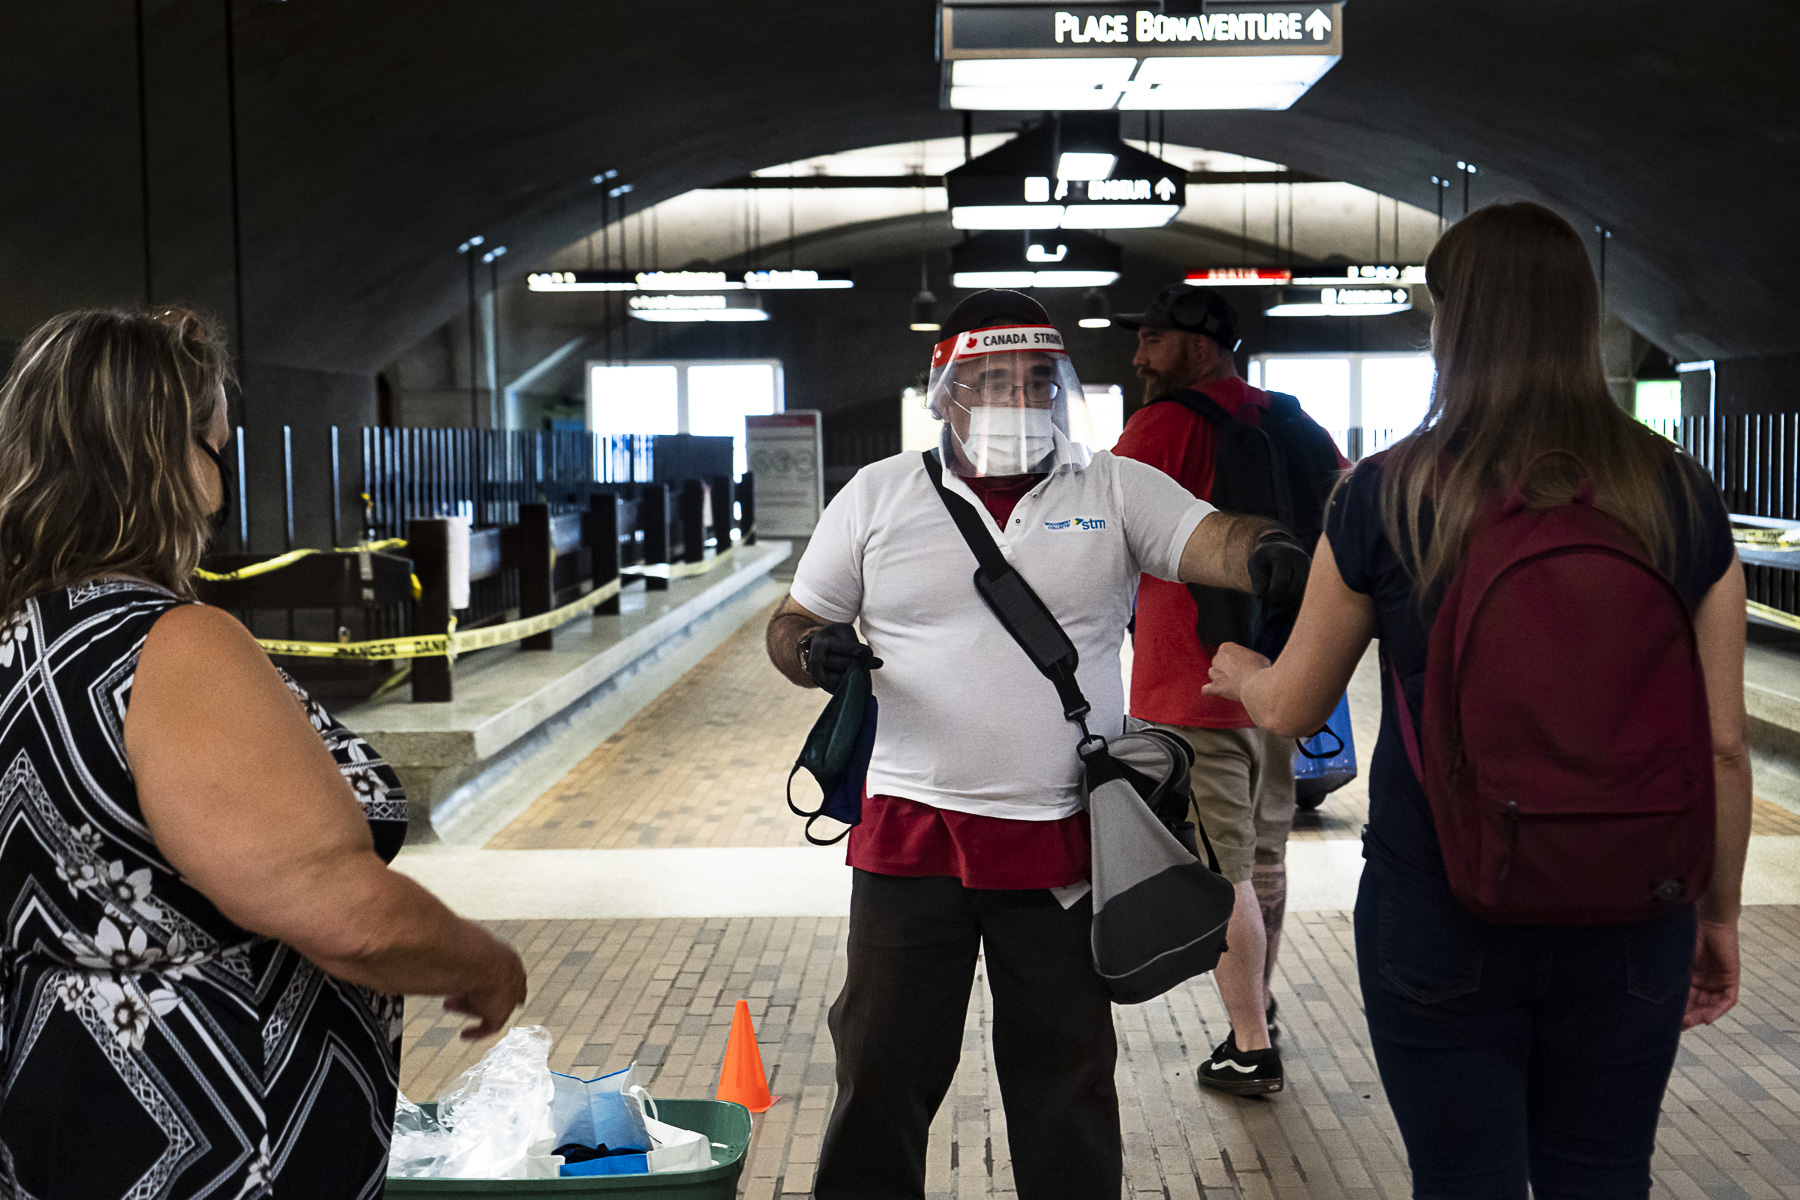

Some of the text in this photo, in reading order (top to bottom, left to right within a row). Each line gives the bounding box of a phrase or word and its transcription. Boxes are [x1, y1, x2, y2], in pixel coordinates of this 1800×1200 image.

[1055, 10, 1303, 43] PLACE BONAVENTURE
[983, 334, 1027, 346] CANADA
[1081, 519, 1105, 530] stm
